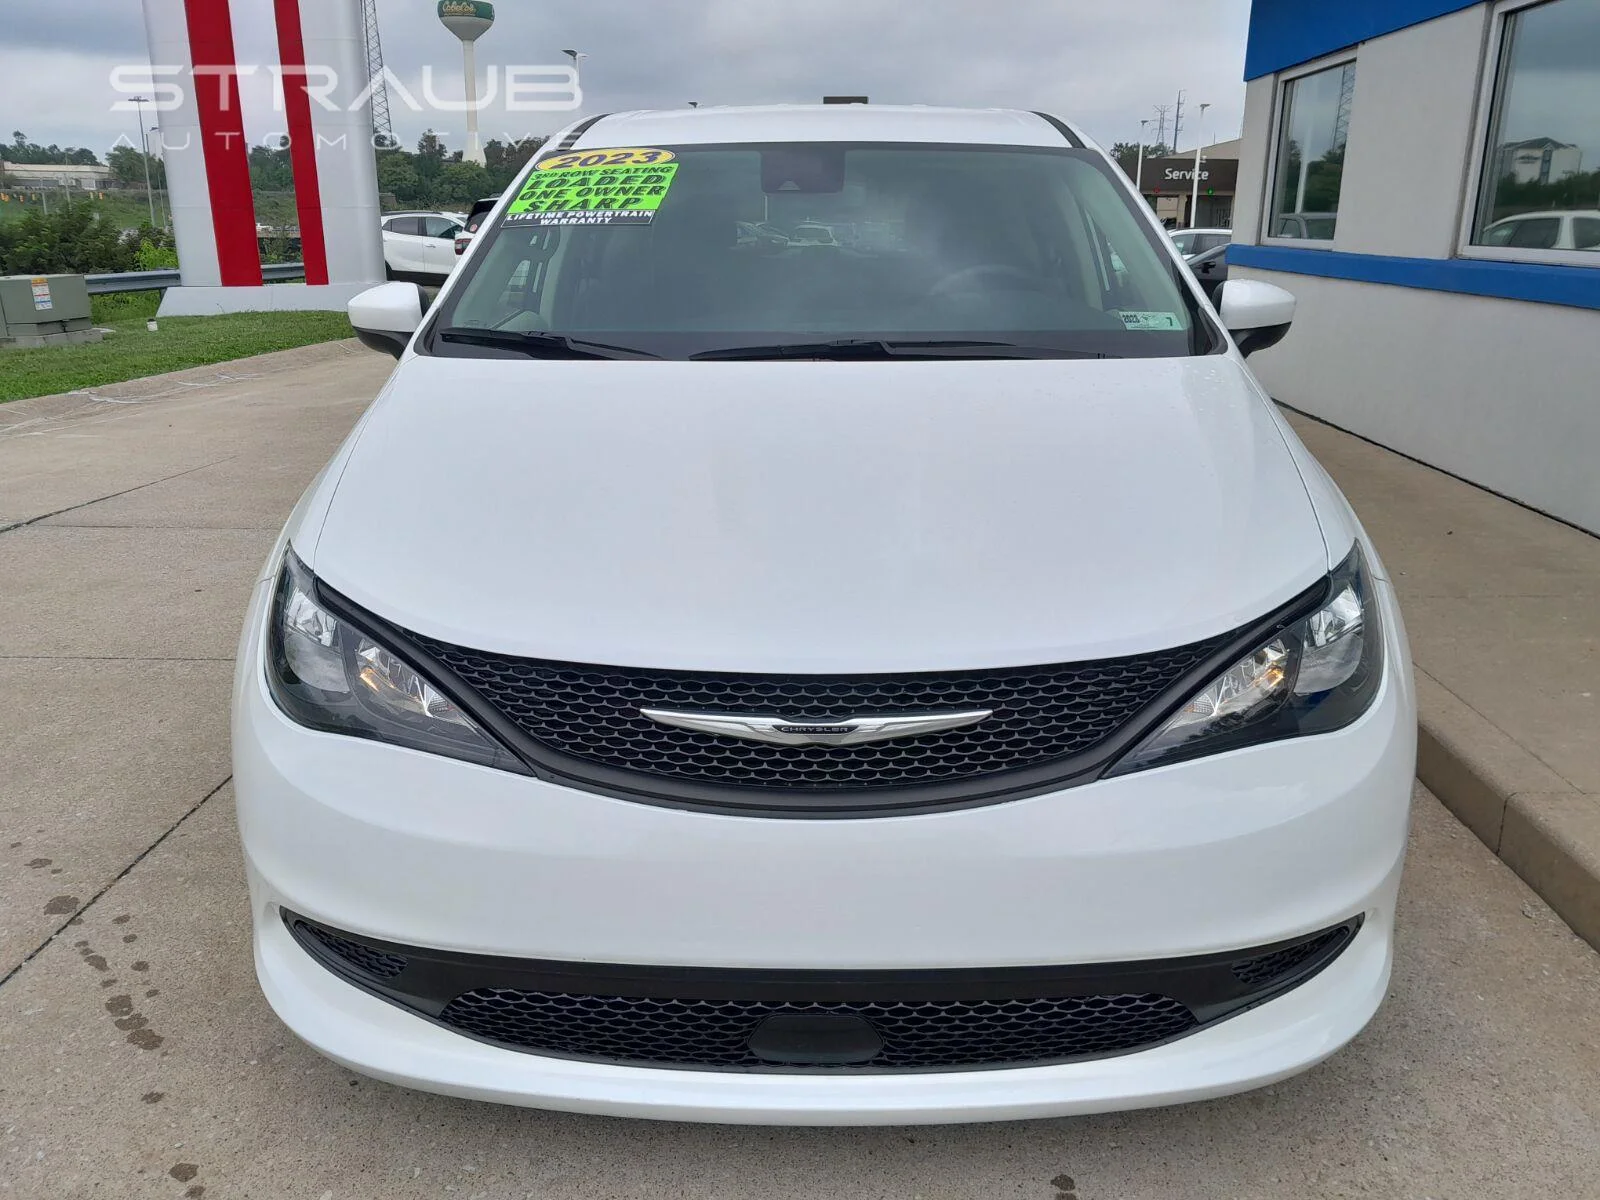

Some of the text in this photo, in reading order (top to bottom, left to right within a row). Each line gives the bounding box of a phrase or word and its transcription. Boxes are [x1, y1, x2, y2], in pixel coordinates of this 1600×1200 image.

[550, 151, 662, 170] 2023
[559, 169, 598, 178] ROW
[599, 166, 673, 176] SEATING
[1164, 168, 1209, 180] Service
[526, 174, 665, 190] LOADED
[519, 185, 667, 201] ONE OWNER
[523, 197, 643, 213] SHARP
[507, 210, 653, 221] LIFETIME POWERTRAIN
[540, 217, 612, 225] WARRANTY
